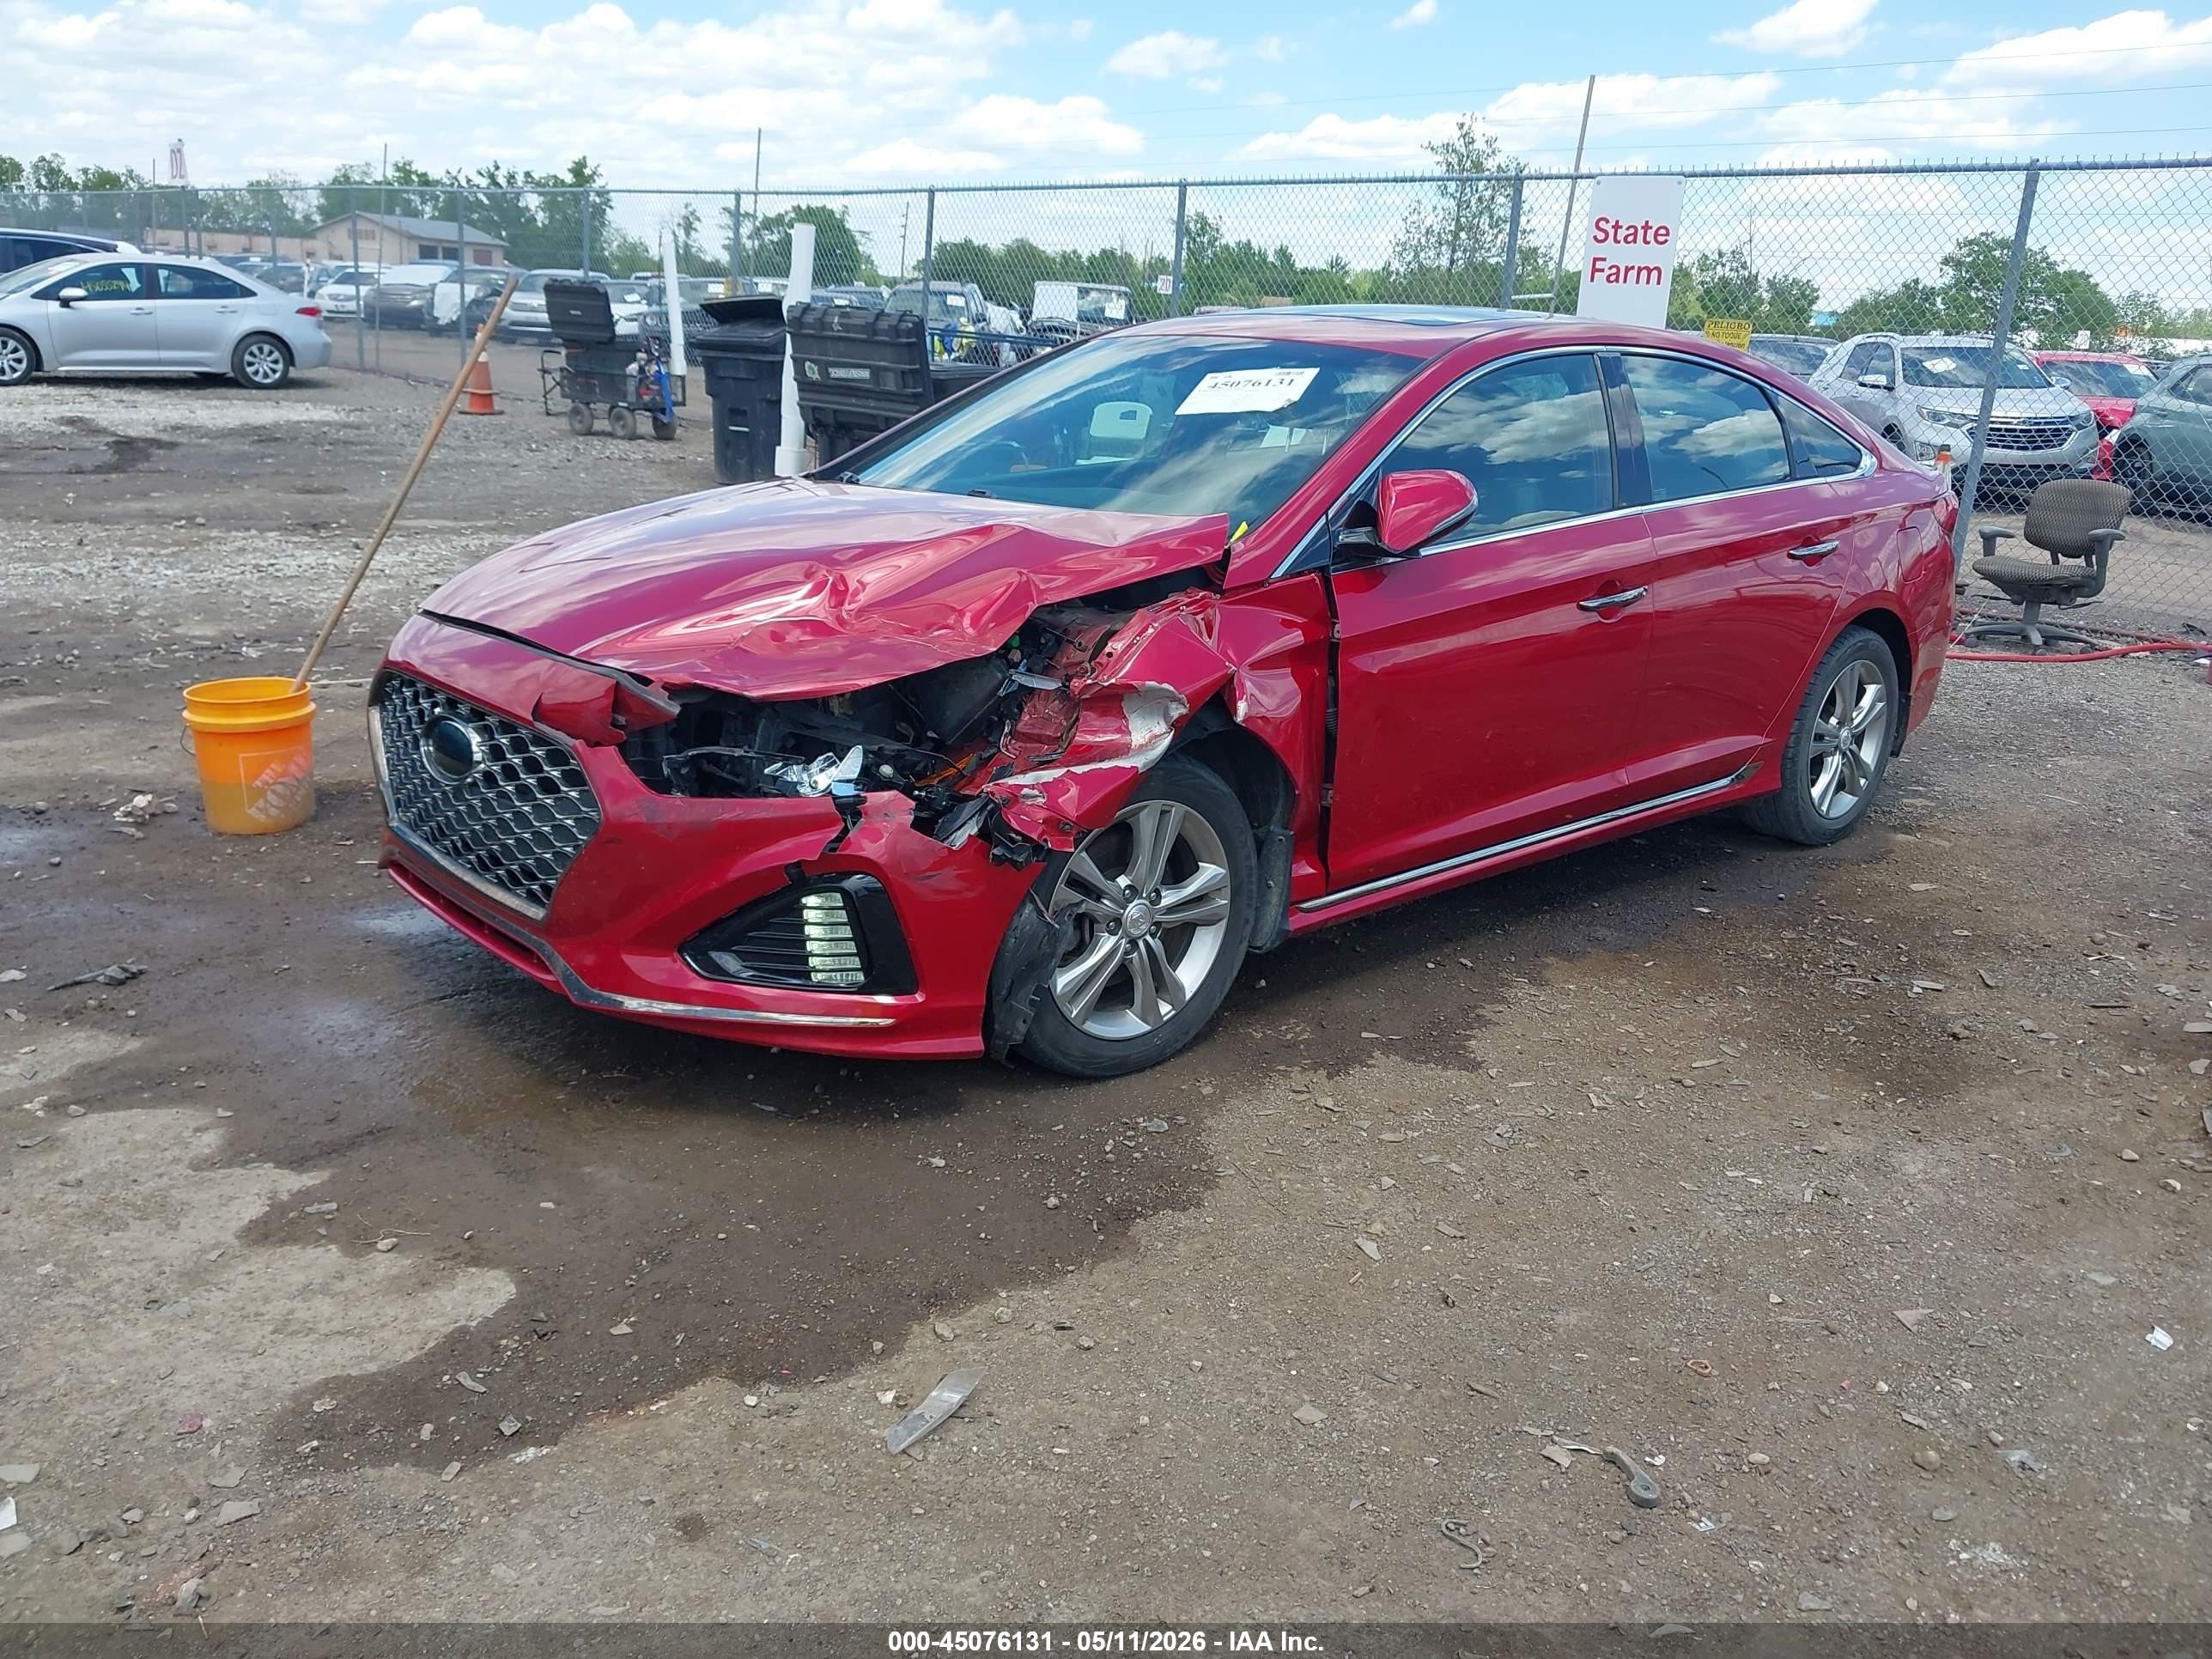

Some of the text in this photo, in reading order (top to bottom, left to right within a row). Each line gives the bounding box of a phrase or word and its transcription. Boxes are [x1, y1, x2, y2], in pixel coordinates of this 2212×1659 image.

[1593, 216, 1670, 245] State
[1589, 257, 1662, 286] Farm
[1708, 320, 1750, 331] PELIGRO
[1722, 331, 1741, 340] TOQUE
[1207, 378, 1295, 389] 45076131
